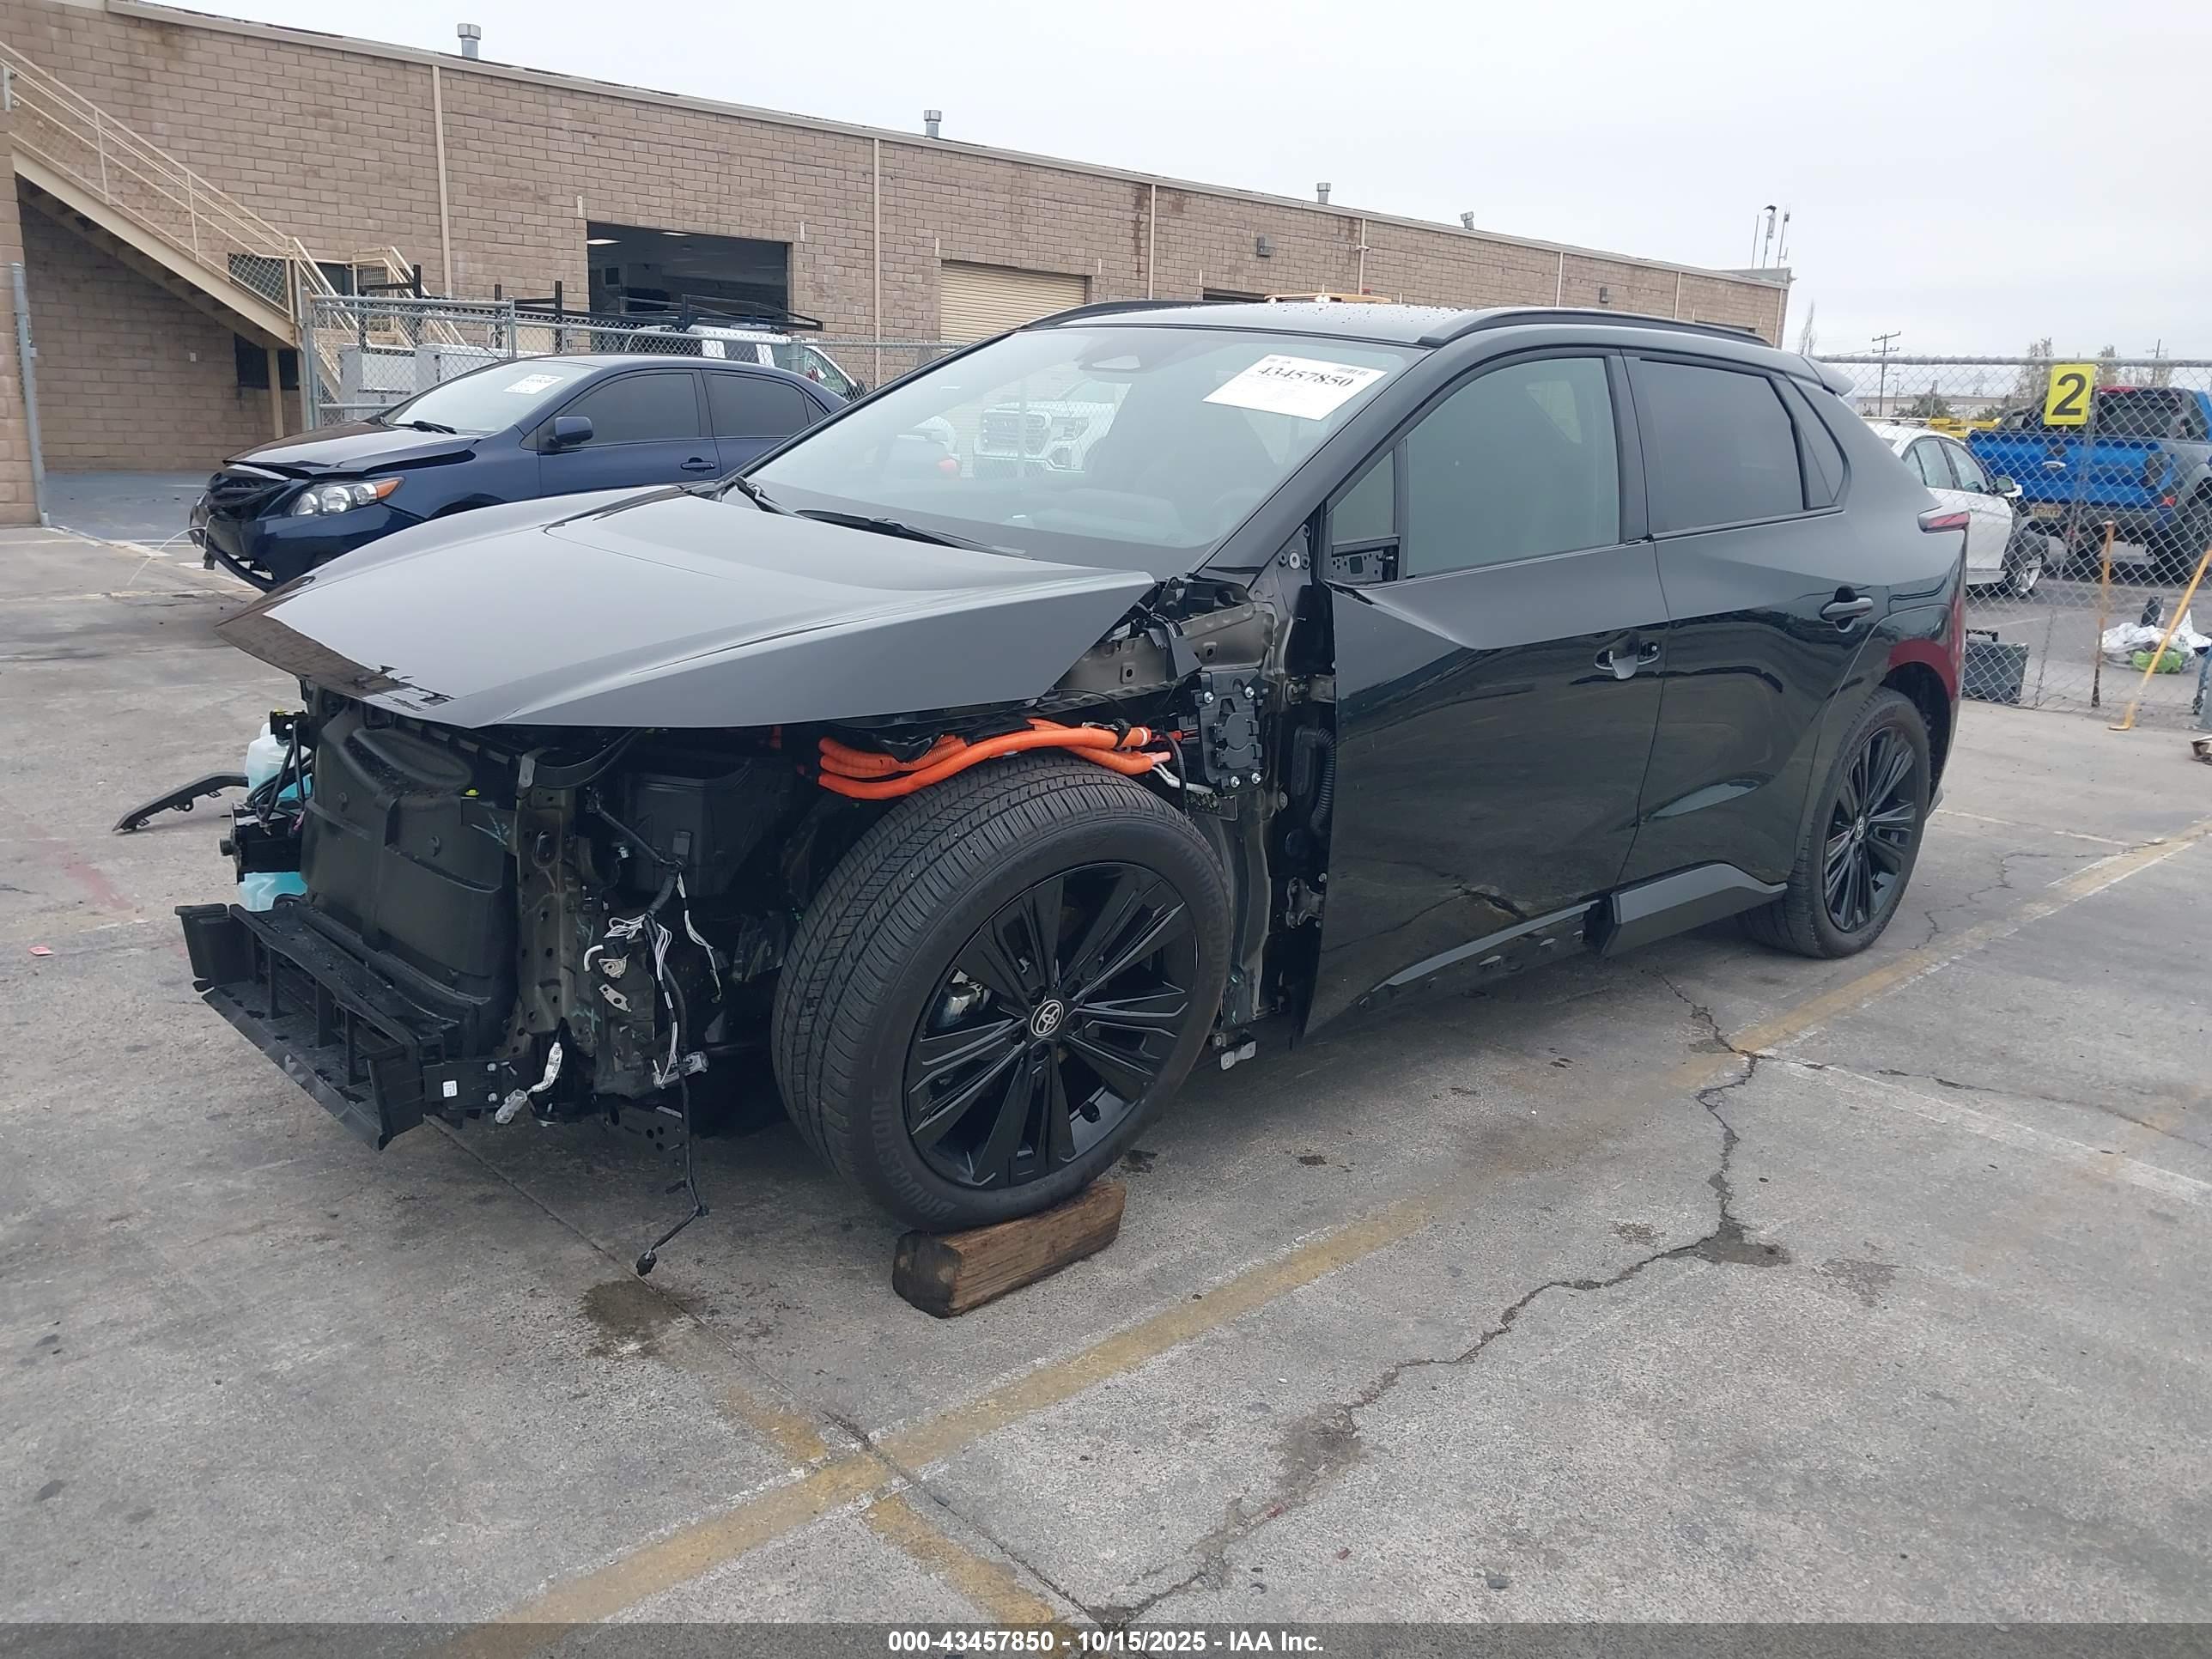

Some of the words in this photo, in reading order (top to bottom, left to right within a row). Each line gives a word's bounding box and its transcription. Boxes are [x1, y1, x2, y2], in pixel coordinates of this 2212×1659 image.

[1257, 367, 1354, 387] 43457850
[2051, 374, 2087, 416] 2
[871, 1085, 957, 1221] BRIDGESTONE
